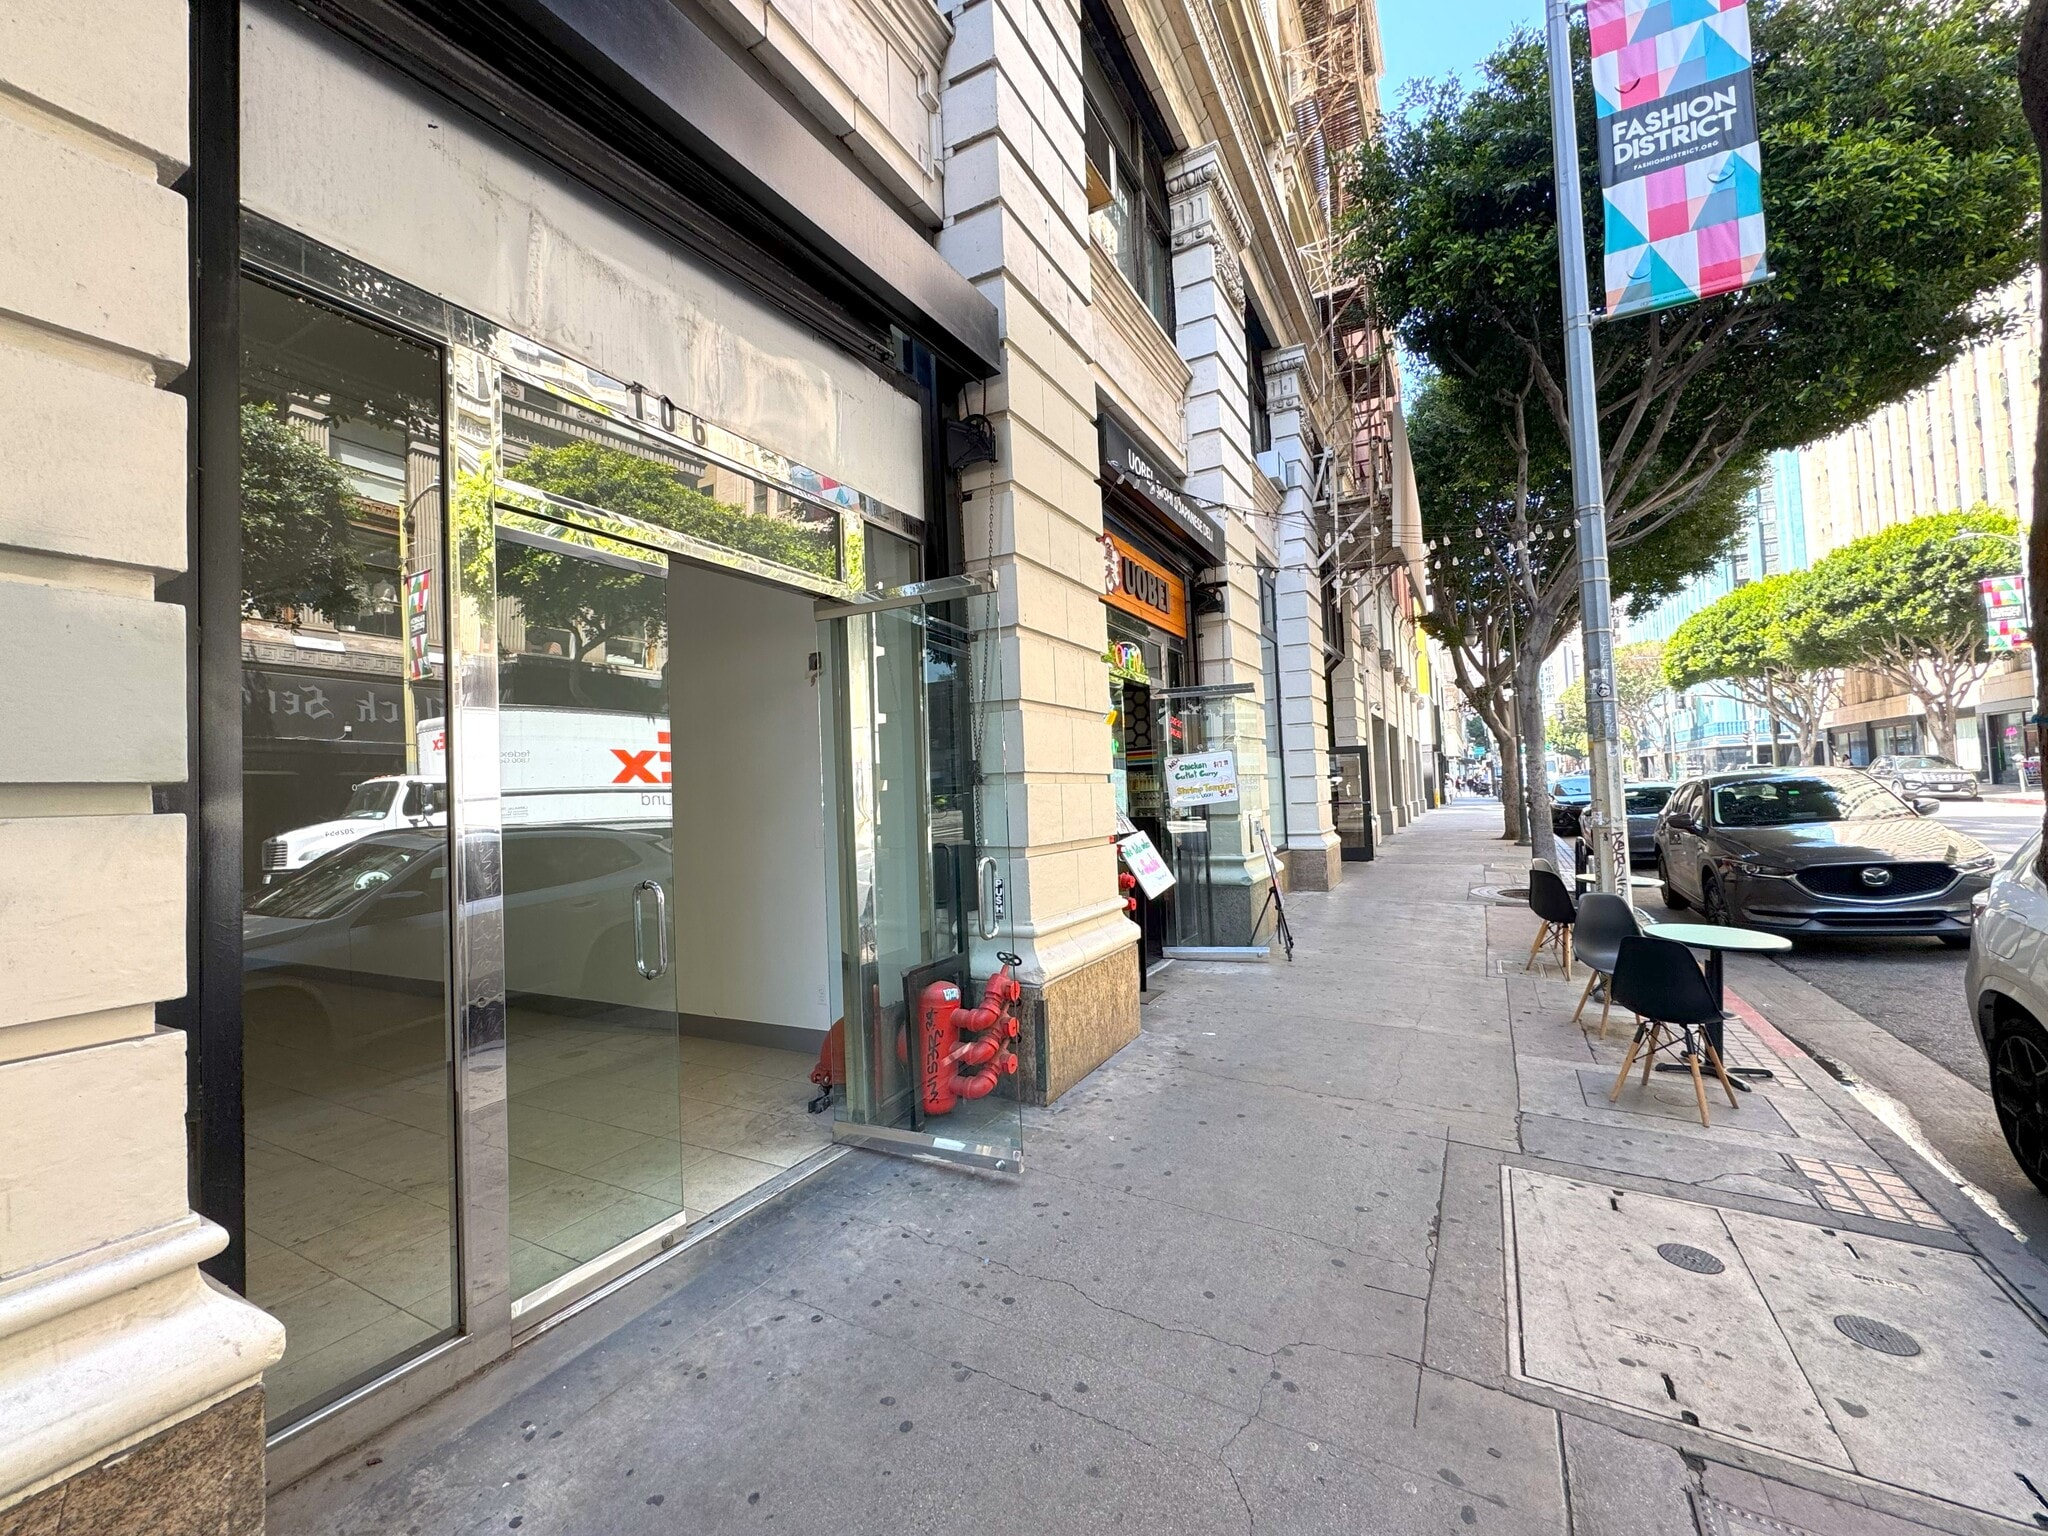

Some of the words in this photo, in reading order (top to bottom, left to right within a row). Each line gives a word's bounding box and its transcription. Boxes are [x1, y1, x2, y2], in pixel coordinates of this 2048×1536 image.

[1612, 85, 1737, 144] FASHION
[1613, 107, 1737, 165] DISTRICT
[1633, 140, 1720, 170] FASHIONDISTRICT.ORG
[630, 381, 706, 446] 106
[1121, 556, 1171, 614] UOBEI
[1115, 643, 1142, 673] OPEN
[1175, 771, 1198, 780] Cutlet
[1199, 769, 1219, 778] Curry
[1179, 762, 1208, 771] Chicken
[995, 879, 1003, 913] PUSH
[1634, 1333, 1679, 1350] WATER
